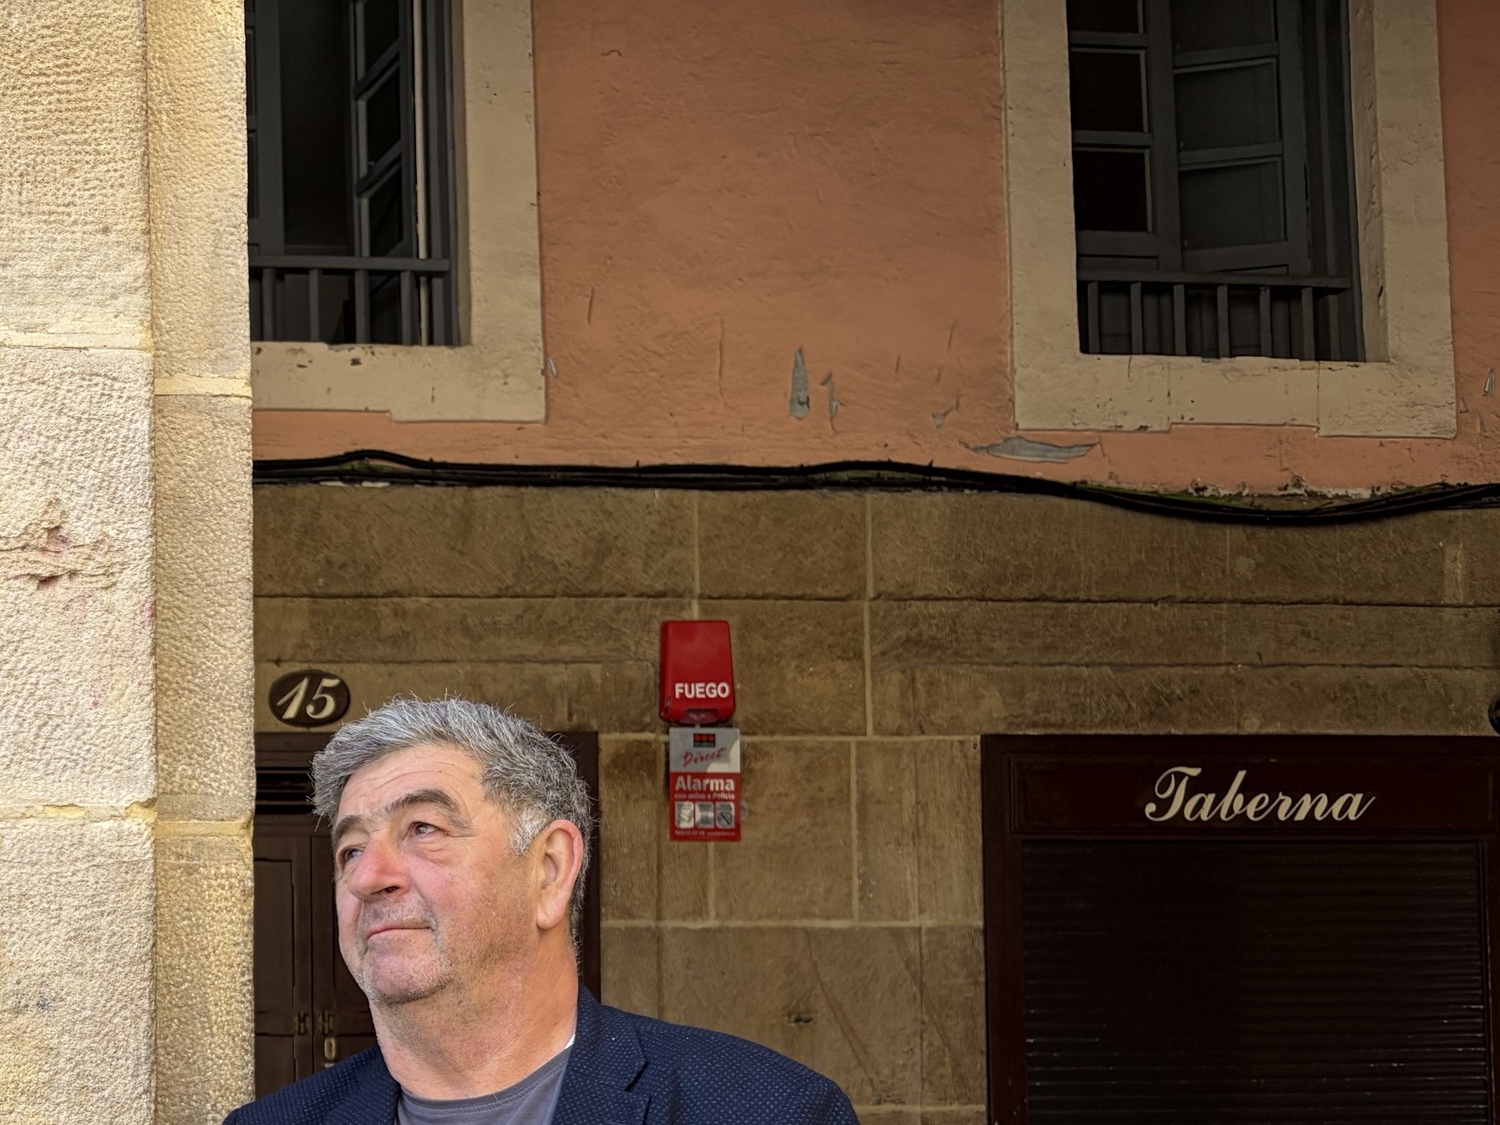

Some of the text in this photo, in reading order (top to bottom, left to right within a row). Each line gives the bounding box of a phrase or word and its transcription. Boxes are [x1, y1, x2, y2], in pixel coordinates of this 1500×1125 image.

[276, 676, 340, 719] 15
[674, 682, 730, 699] FUEGO
[682, 747, 727, 768] Direct
[674, 774, 735, 791] Alarma
[1145, 766, 1376, 822] Taberna
